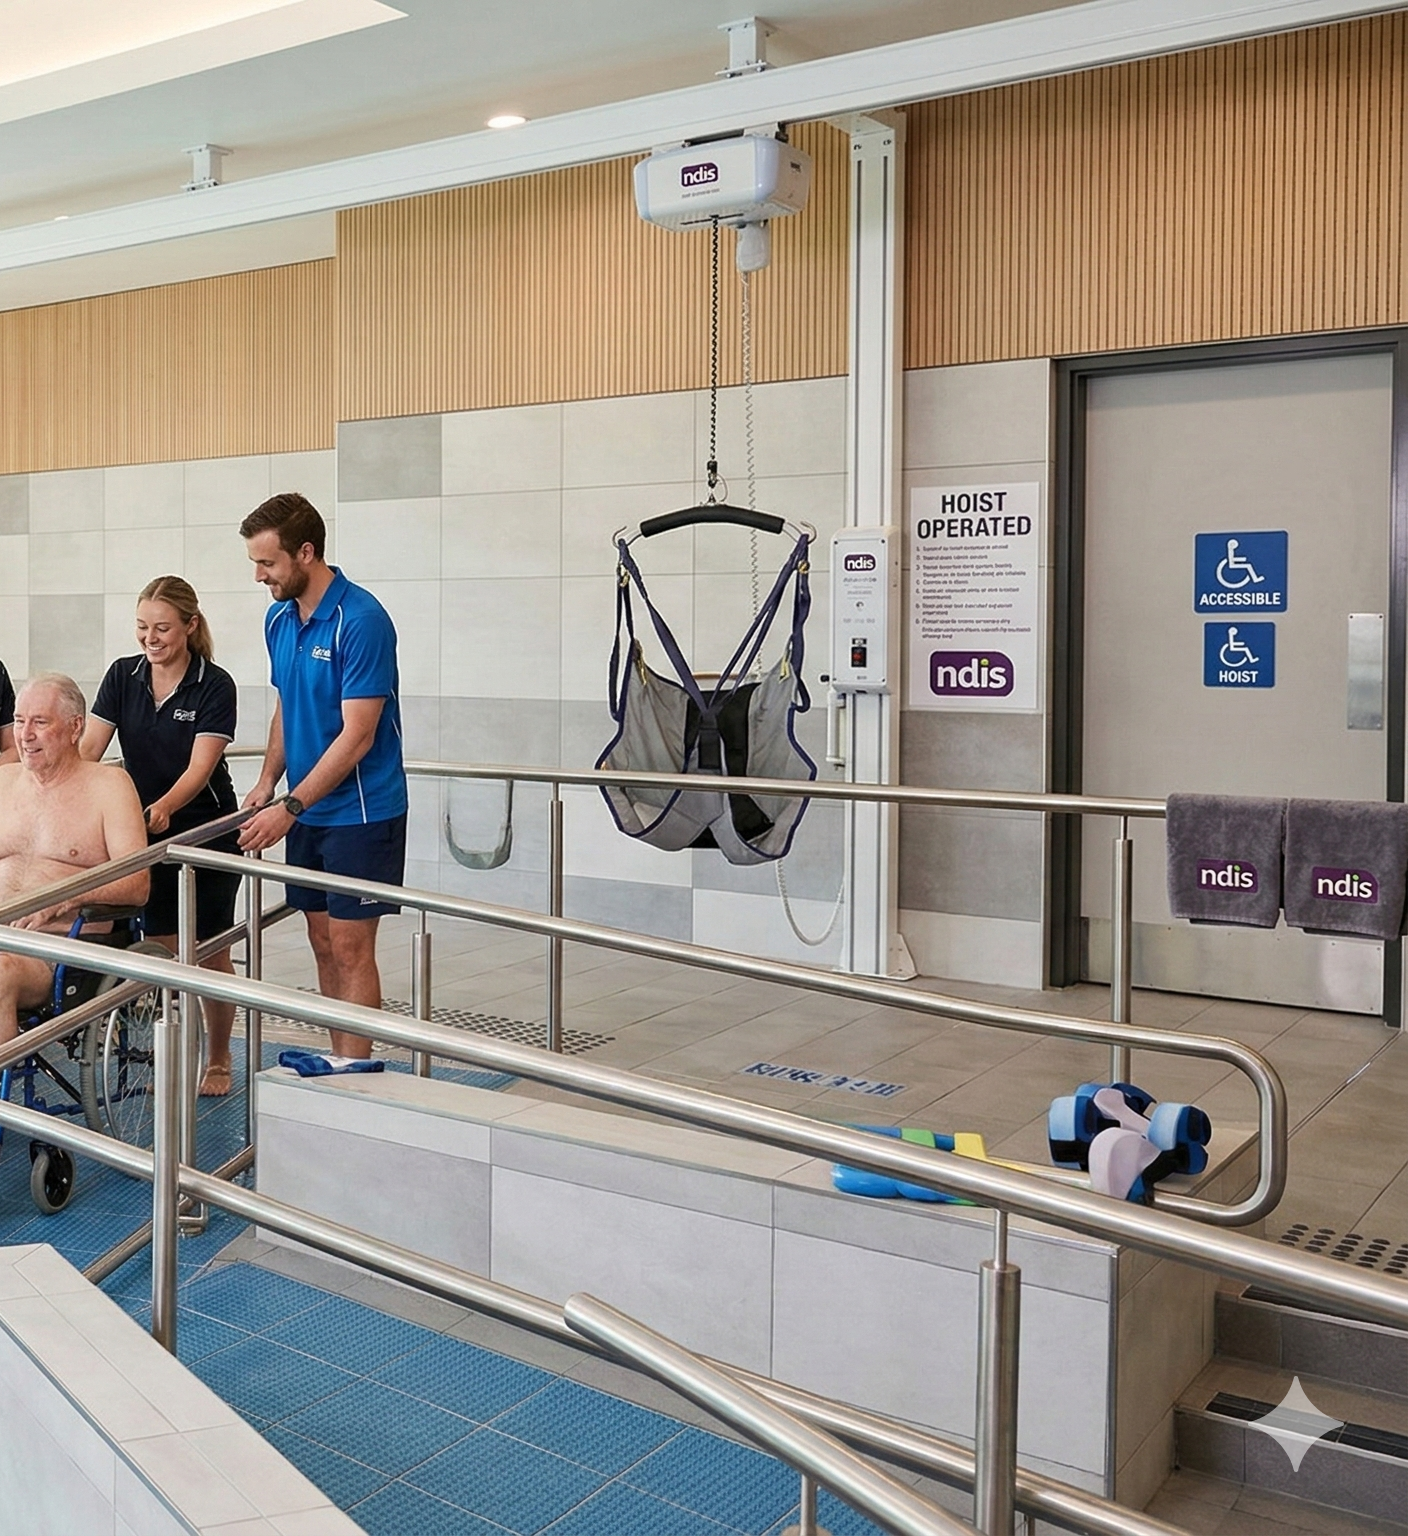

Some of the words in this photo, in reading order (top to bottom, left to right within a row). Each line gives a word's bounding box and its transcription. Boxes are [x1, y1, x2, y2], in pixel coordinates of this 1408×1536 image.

[683, 165, 716, 185] ndis
[941, 491, 1007, 514] HOIST
[917, 516, 1032, 539] OPERATED
[847, 556, 874, 569] ndis
[1199, 592, 1281, 606] ACCESSIBLE
[937, 658, 1007, 688] ndis
[1219, 670, 1259, 683] HOIST
[1201, 865, 1254, 888] ndis
[1317, 874, 1373, 898] ndis
